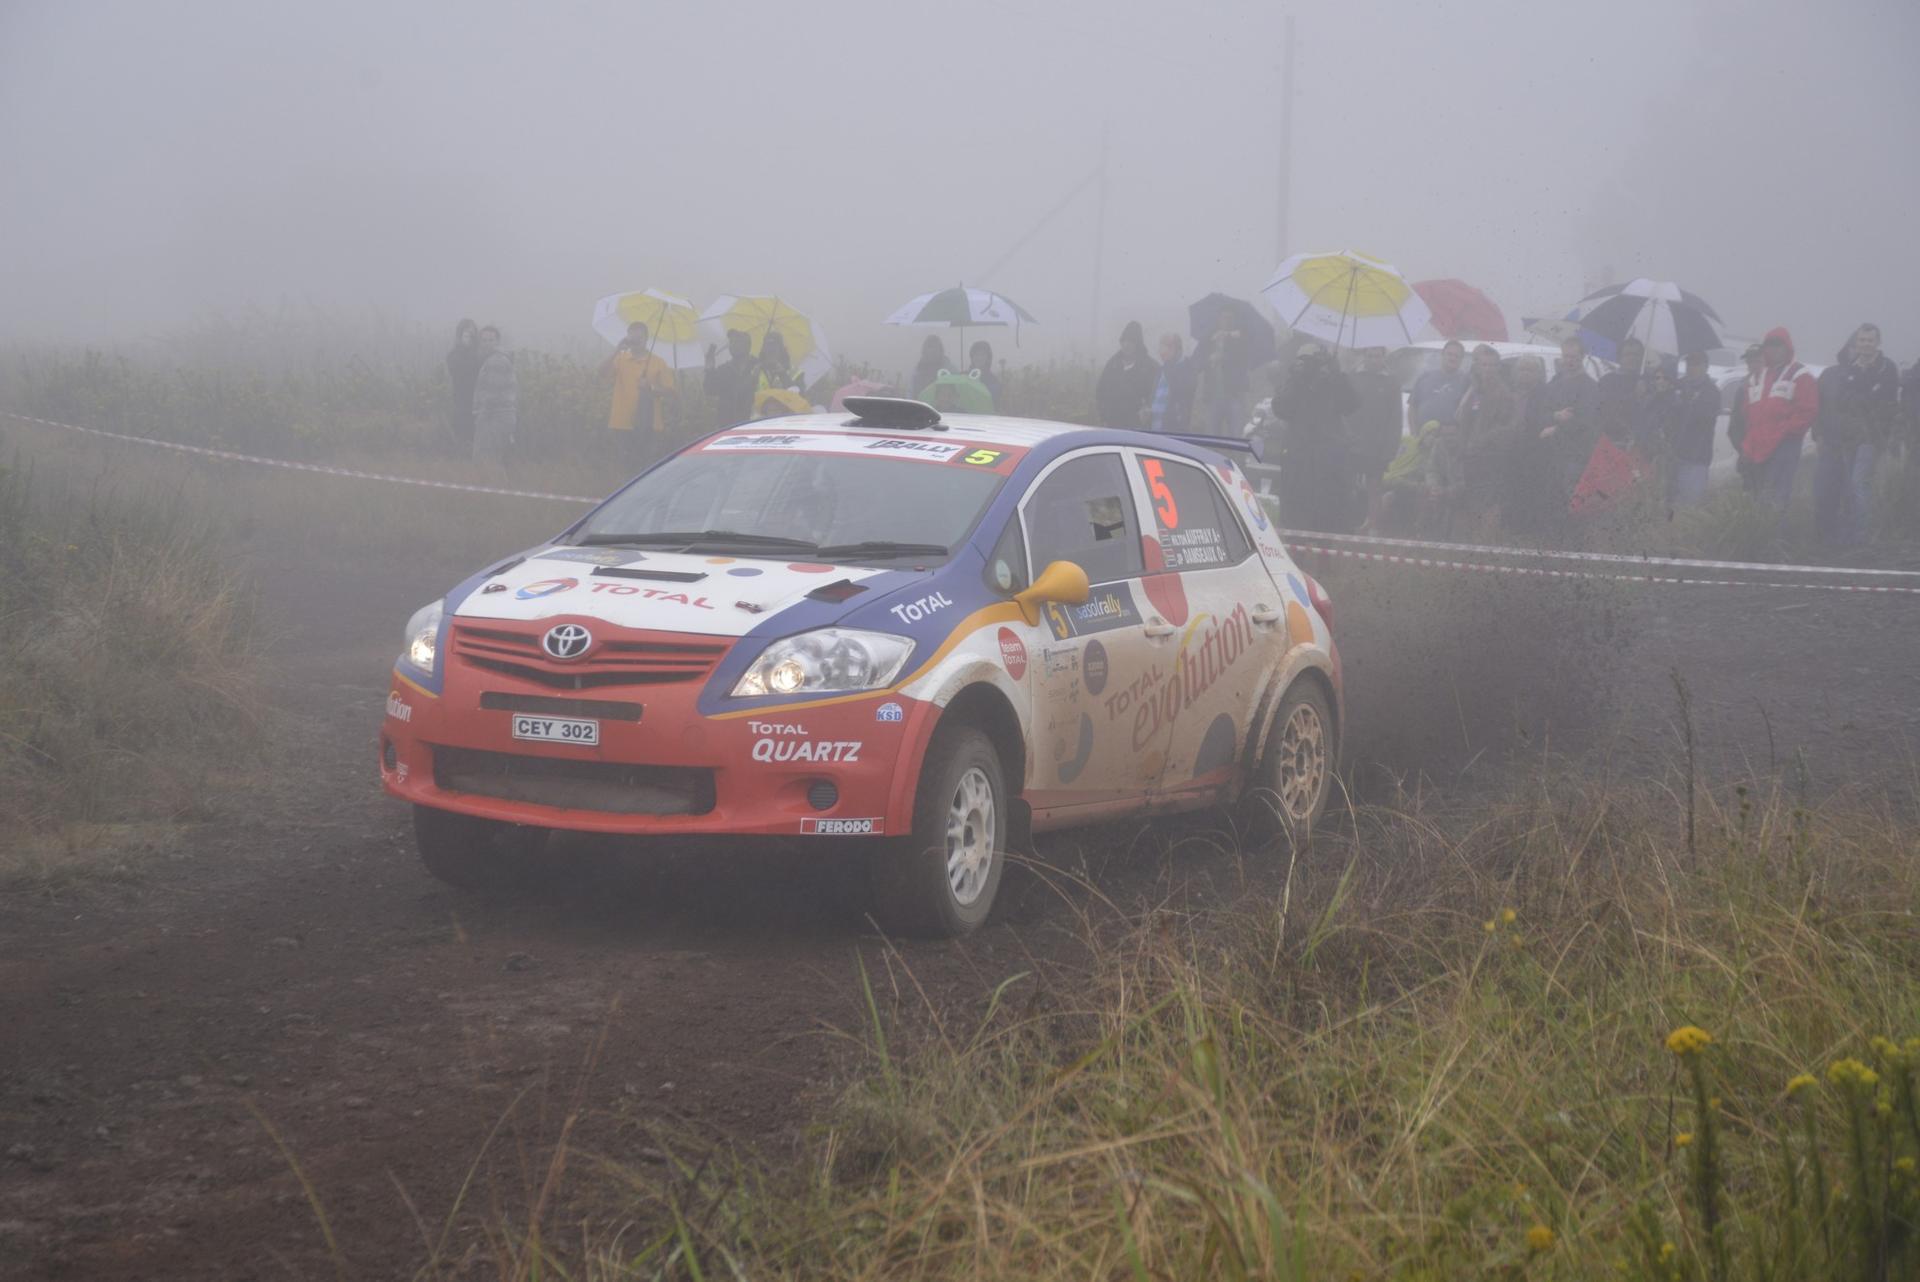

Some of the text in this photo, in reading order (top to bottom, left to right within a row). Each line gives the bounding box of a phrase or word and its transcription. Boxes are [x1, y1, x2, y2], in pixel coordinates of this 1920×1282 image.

[964, 449, 1001, 465] 5
[1142, 459, 1178, 529] 5
[591, 582, 715, 610] TOTAL
[890, 591, 953, 624] TOTAL
[1076, 592, 1122, 618] sasolrally
[1046, 600, 1068, 640] 5
[1002, 654, 1026, 665] TOTAL
[1132, 602, 1254, 752] evolution
[1104, 664, 1164, 721] TOTAL
[748, 721, 808, 735] TOTAL
[877, 710, 902, 721] KSD
[518, 719, 594, 739] CEY 302
[752, 738, 862, 762] QUARTZ
[817, 820, 872, 833] FERODO
